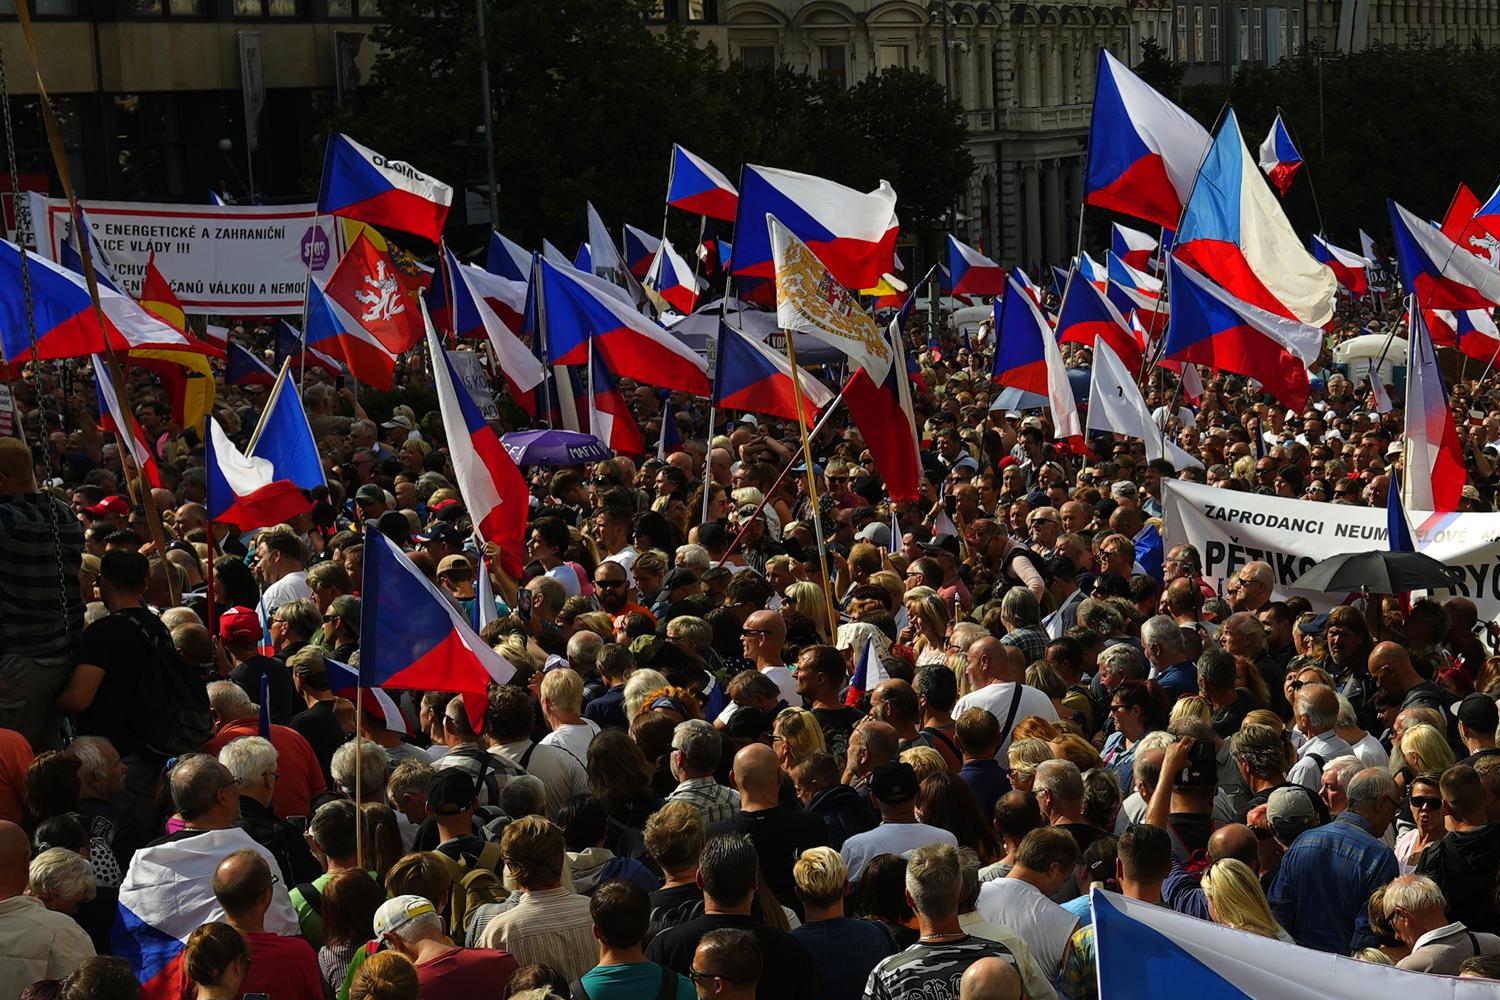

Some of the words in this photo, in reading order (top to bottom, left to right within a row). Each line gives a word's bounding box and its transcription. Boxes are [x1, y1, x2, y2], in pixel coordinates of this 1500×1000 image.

[106, 223, 196, 239] ENERGETICKÉ
[202, 227, 210, 239] A
[215, 225, 286, 239] ZAHRANIČNÍ
[131, 238, 173, 253] VLÁDY
[177, 243, 190, 254] !!!
[209, 281, 255, 295] VÁLKOU
[259, 283, 267, 294] A
[1204, 505, 1324, 535] ZAPRODANCI
